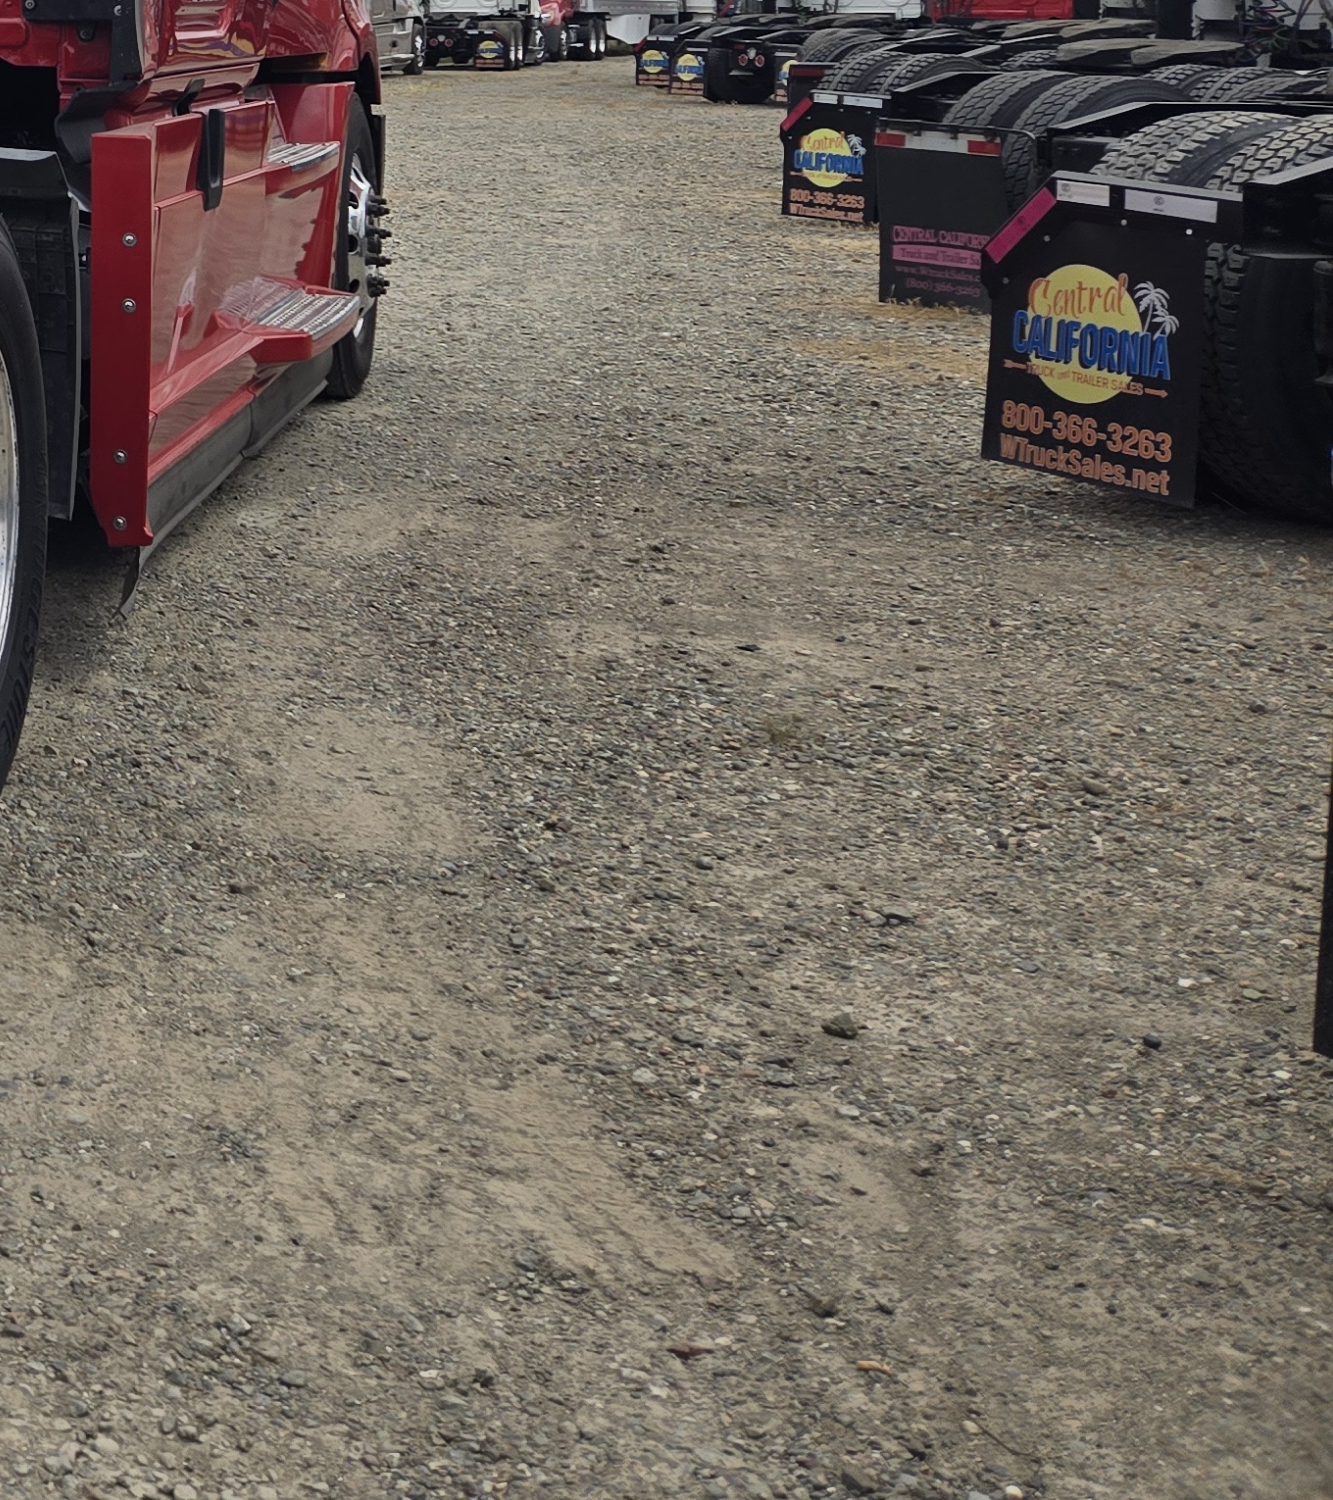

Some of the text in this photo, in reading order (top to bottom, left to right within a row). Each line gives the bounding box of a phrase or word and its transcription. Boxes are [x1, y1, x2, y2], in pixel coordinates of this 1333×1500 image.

[794, 149, 864, 175] CALIFORNIA
[1029, 273, 1128, 318] Central
[1013, 310, 1170, 380] CALIFORNIA
[1026, 362, 1054, 377] TRUCK
[1072, 371, 1108, 389] TRAILER
[1111, 379, 1144, 396] SALES
[1002, 400, 1172, 462] 800-366-3263
[1000, 432, 1170, 496] WTruckSales.net
